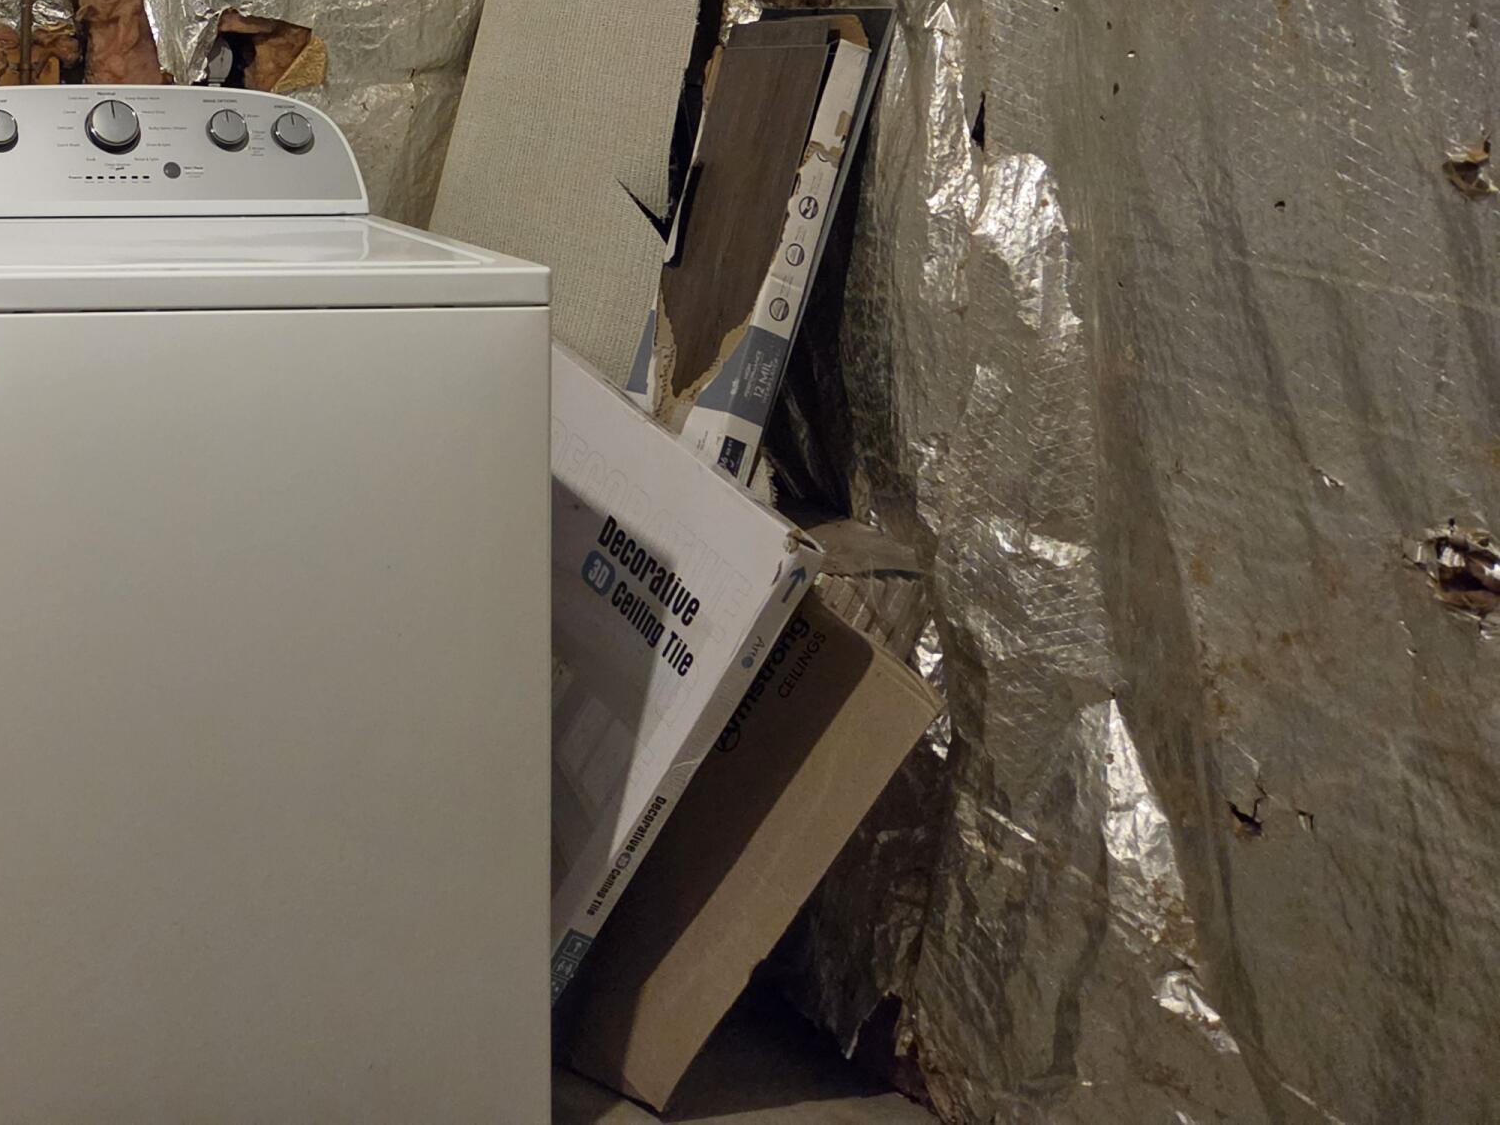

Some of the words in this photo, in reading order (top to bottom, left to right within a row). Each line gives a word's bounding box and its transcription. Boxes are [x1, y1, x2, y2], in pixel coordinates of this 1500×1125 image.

[597, 514, 700, 627] Decorative
[587, 557, 612, 590] 3D
[611, 581, 666, 648] Ceiling
[662, 631, 694, 677] Tile
[777, 630, 827, 699] CEILINGS
[626, 795, 668, 853] Decorative
